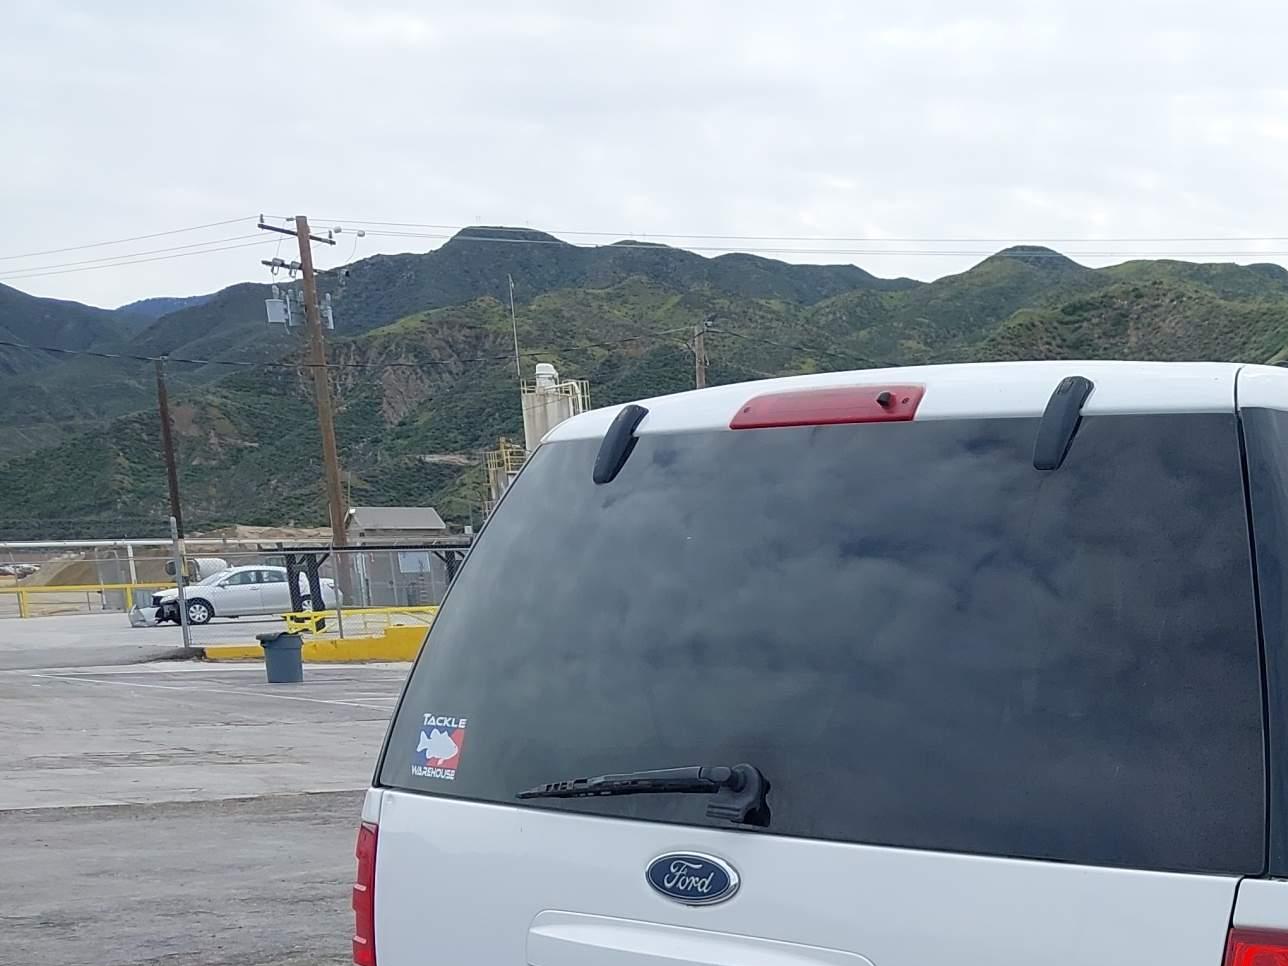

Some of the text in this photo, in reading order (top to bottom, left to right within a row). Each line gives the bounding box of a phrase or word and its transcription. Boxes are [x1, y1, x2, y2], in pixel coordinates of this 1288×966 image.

[422, 713, 468, 729] TACKLE
[411, 764, 456, 781] WAREHOUSE
[663, 859, 715, 893] Ford
